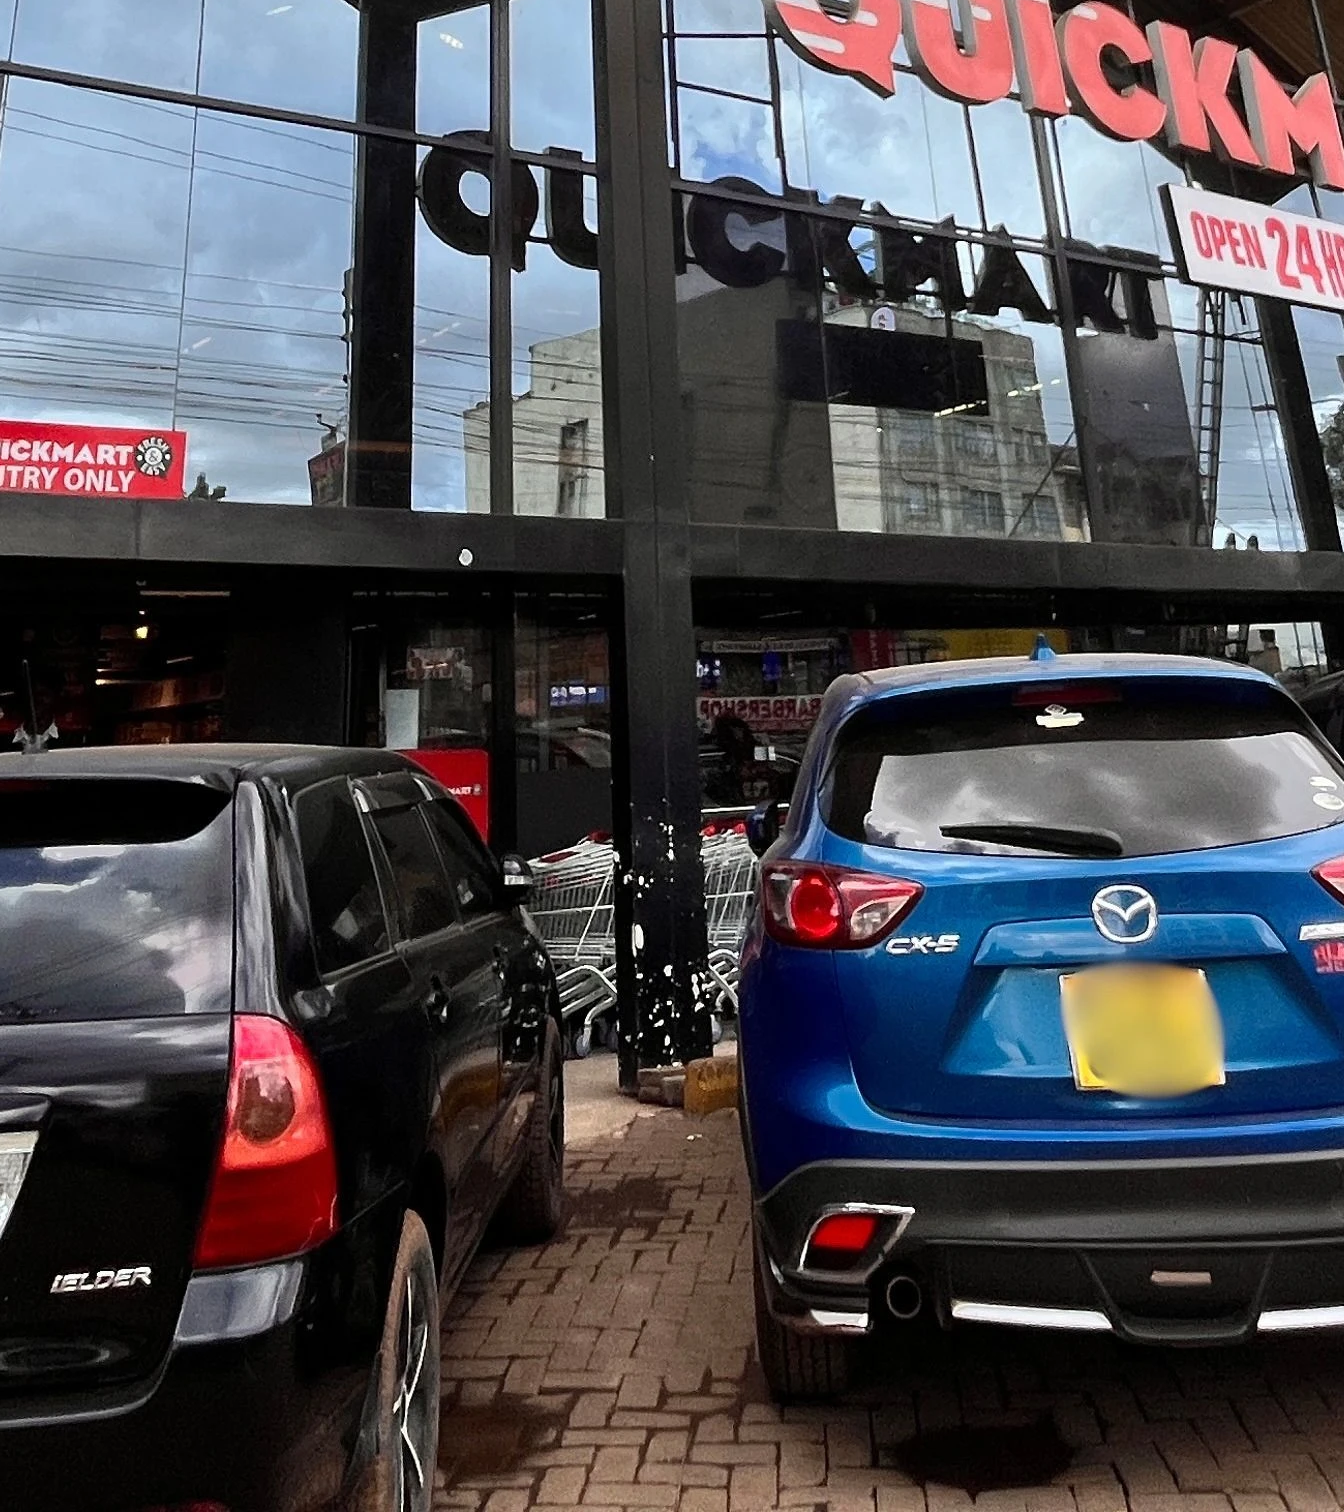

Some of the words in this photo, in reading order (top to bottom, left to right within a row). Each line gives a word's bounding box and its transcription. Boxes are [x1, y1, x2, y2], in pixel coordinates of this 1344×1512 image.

[1190, 211, 1267, 270] OPEN
[1265, 217, 1326, 296] 24
[137, 437, 169, 453] FRESH
[148, 450, 159, 463] &
[140, 461, 166, 476] EASY
[64, 468, 135, 493] ONLY
[885, 934, 960, 955] CX-5
